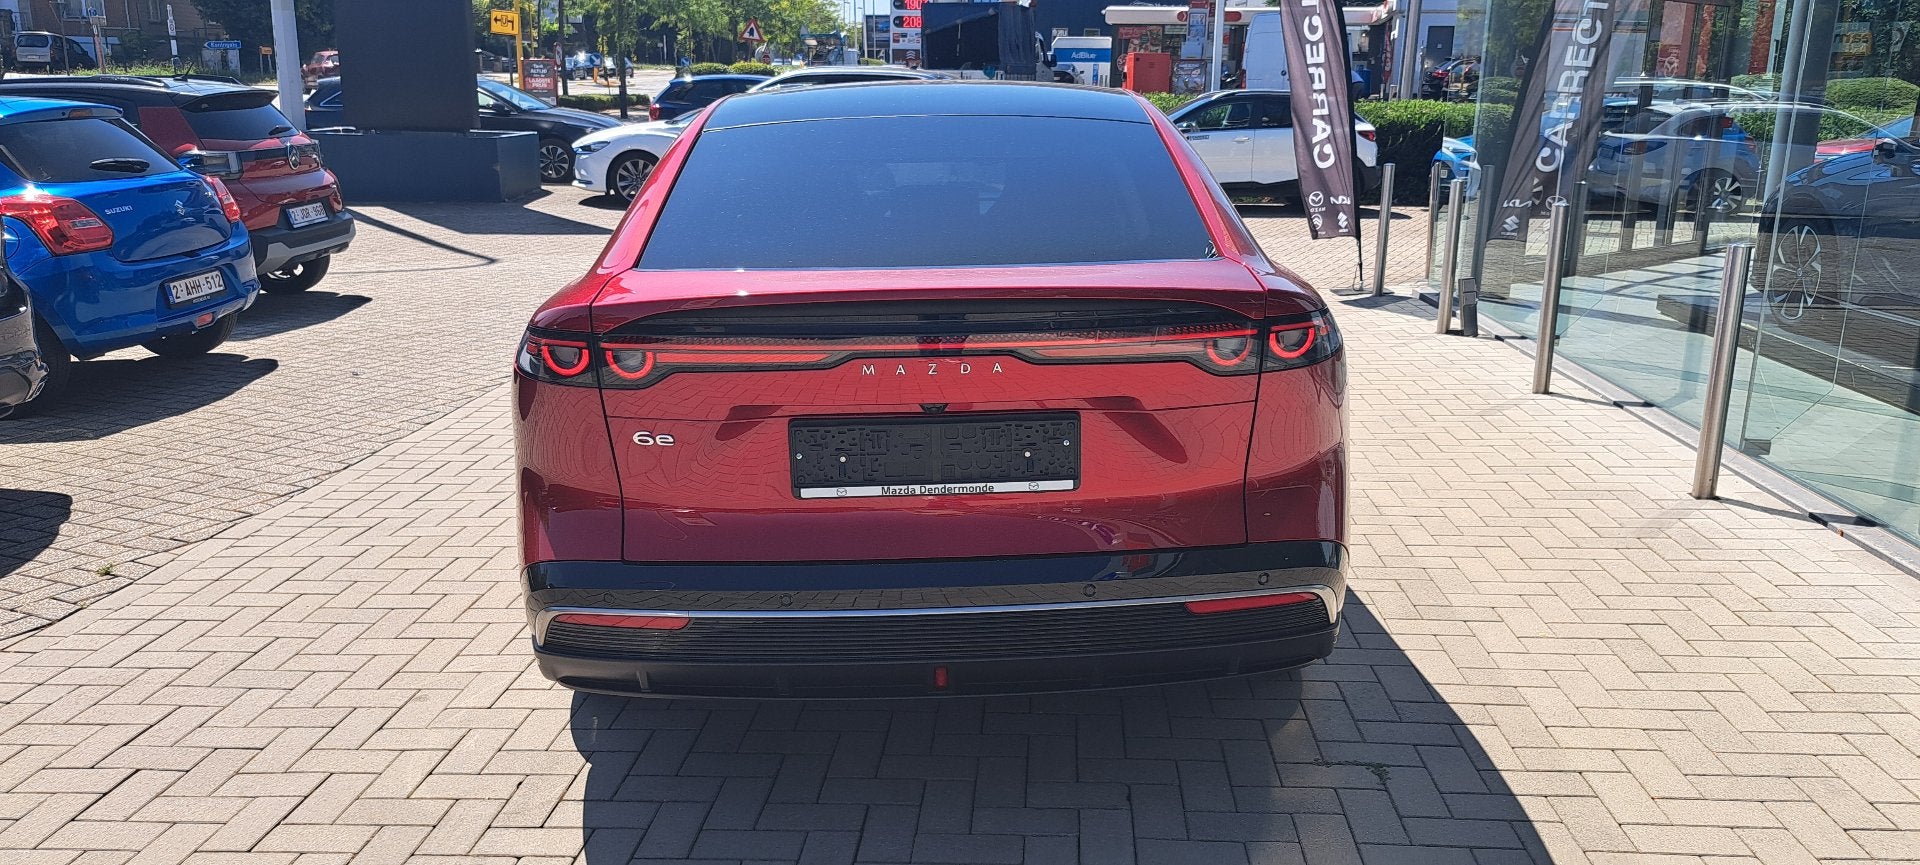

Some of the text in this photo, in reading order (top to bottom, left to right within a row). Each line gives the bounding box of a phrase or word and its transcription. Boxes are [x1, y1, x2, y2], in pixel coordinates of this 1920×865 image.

[903, 16, 922, 28] 208
[1071, 51, 1097, 59] AdBlue
[104, 205, 133, 215] SUZUKI
[862, 362, 1003, 376] MAZDA
[632, 430, 675, 446] 6e
[881, 483, 995, 496] Mazda Dendermonde
